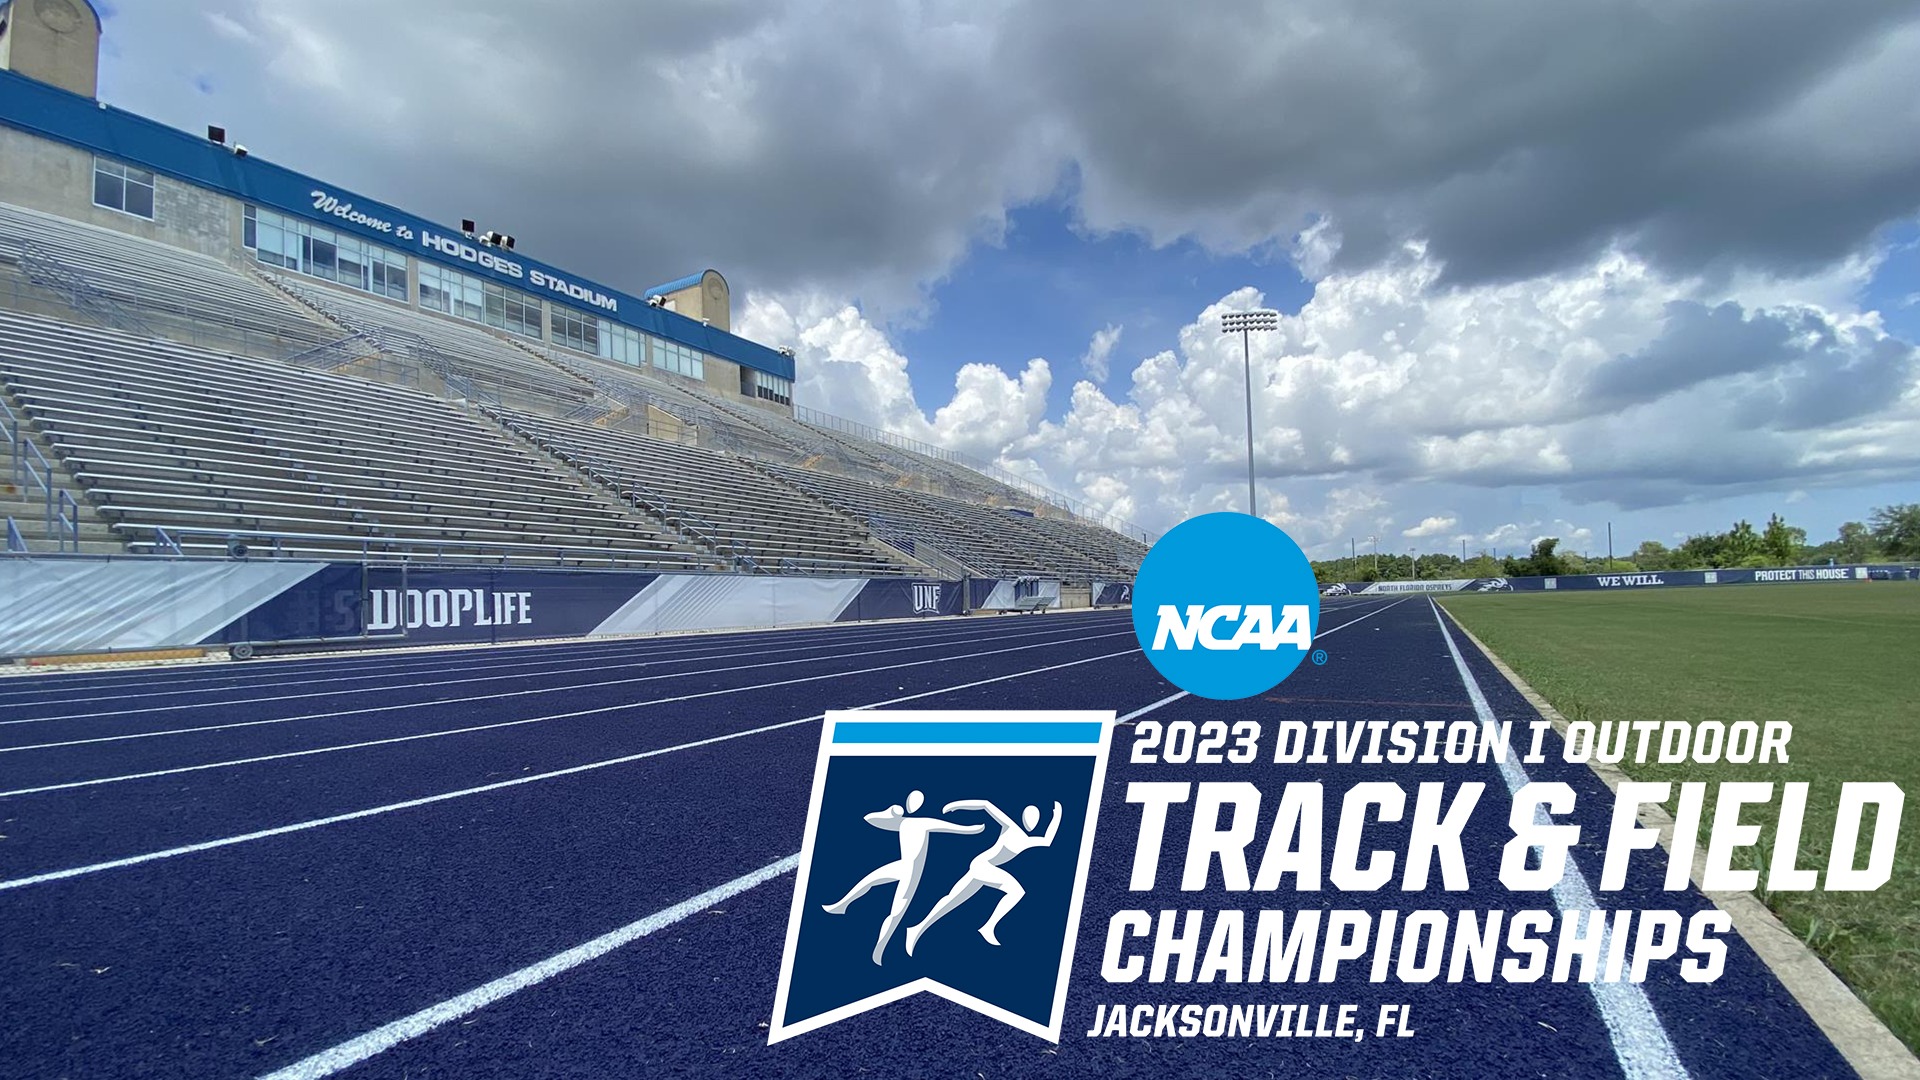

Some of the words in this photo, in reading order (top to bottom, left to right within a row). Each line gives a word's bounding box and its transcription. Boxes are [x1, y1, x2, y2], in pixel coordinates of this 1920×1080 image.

[310, 190, 392, 233] Welcome
[396, 222, 414, 241] to
[422, 231, 523, 279] HODGES
[530, 270, 617, 312] STADIUM
[1597, 576, 1620, 587] WE
[1622, 574, 1664, 586] WILL.
[1755, 570, 1796, 581] PROTECT
[1797, 569, 1815, 580] THIS
[1816, 568, 1849, 579] HOUSE
[1378, 584, 1398, 592] NORTH
[1426, 583, 1452, 591] OSPREYS
[912, 583, 941, 613] UNF
